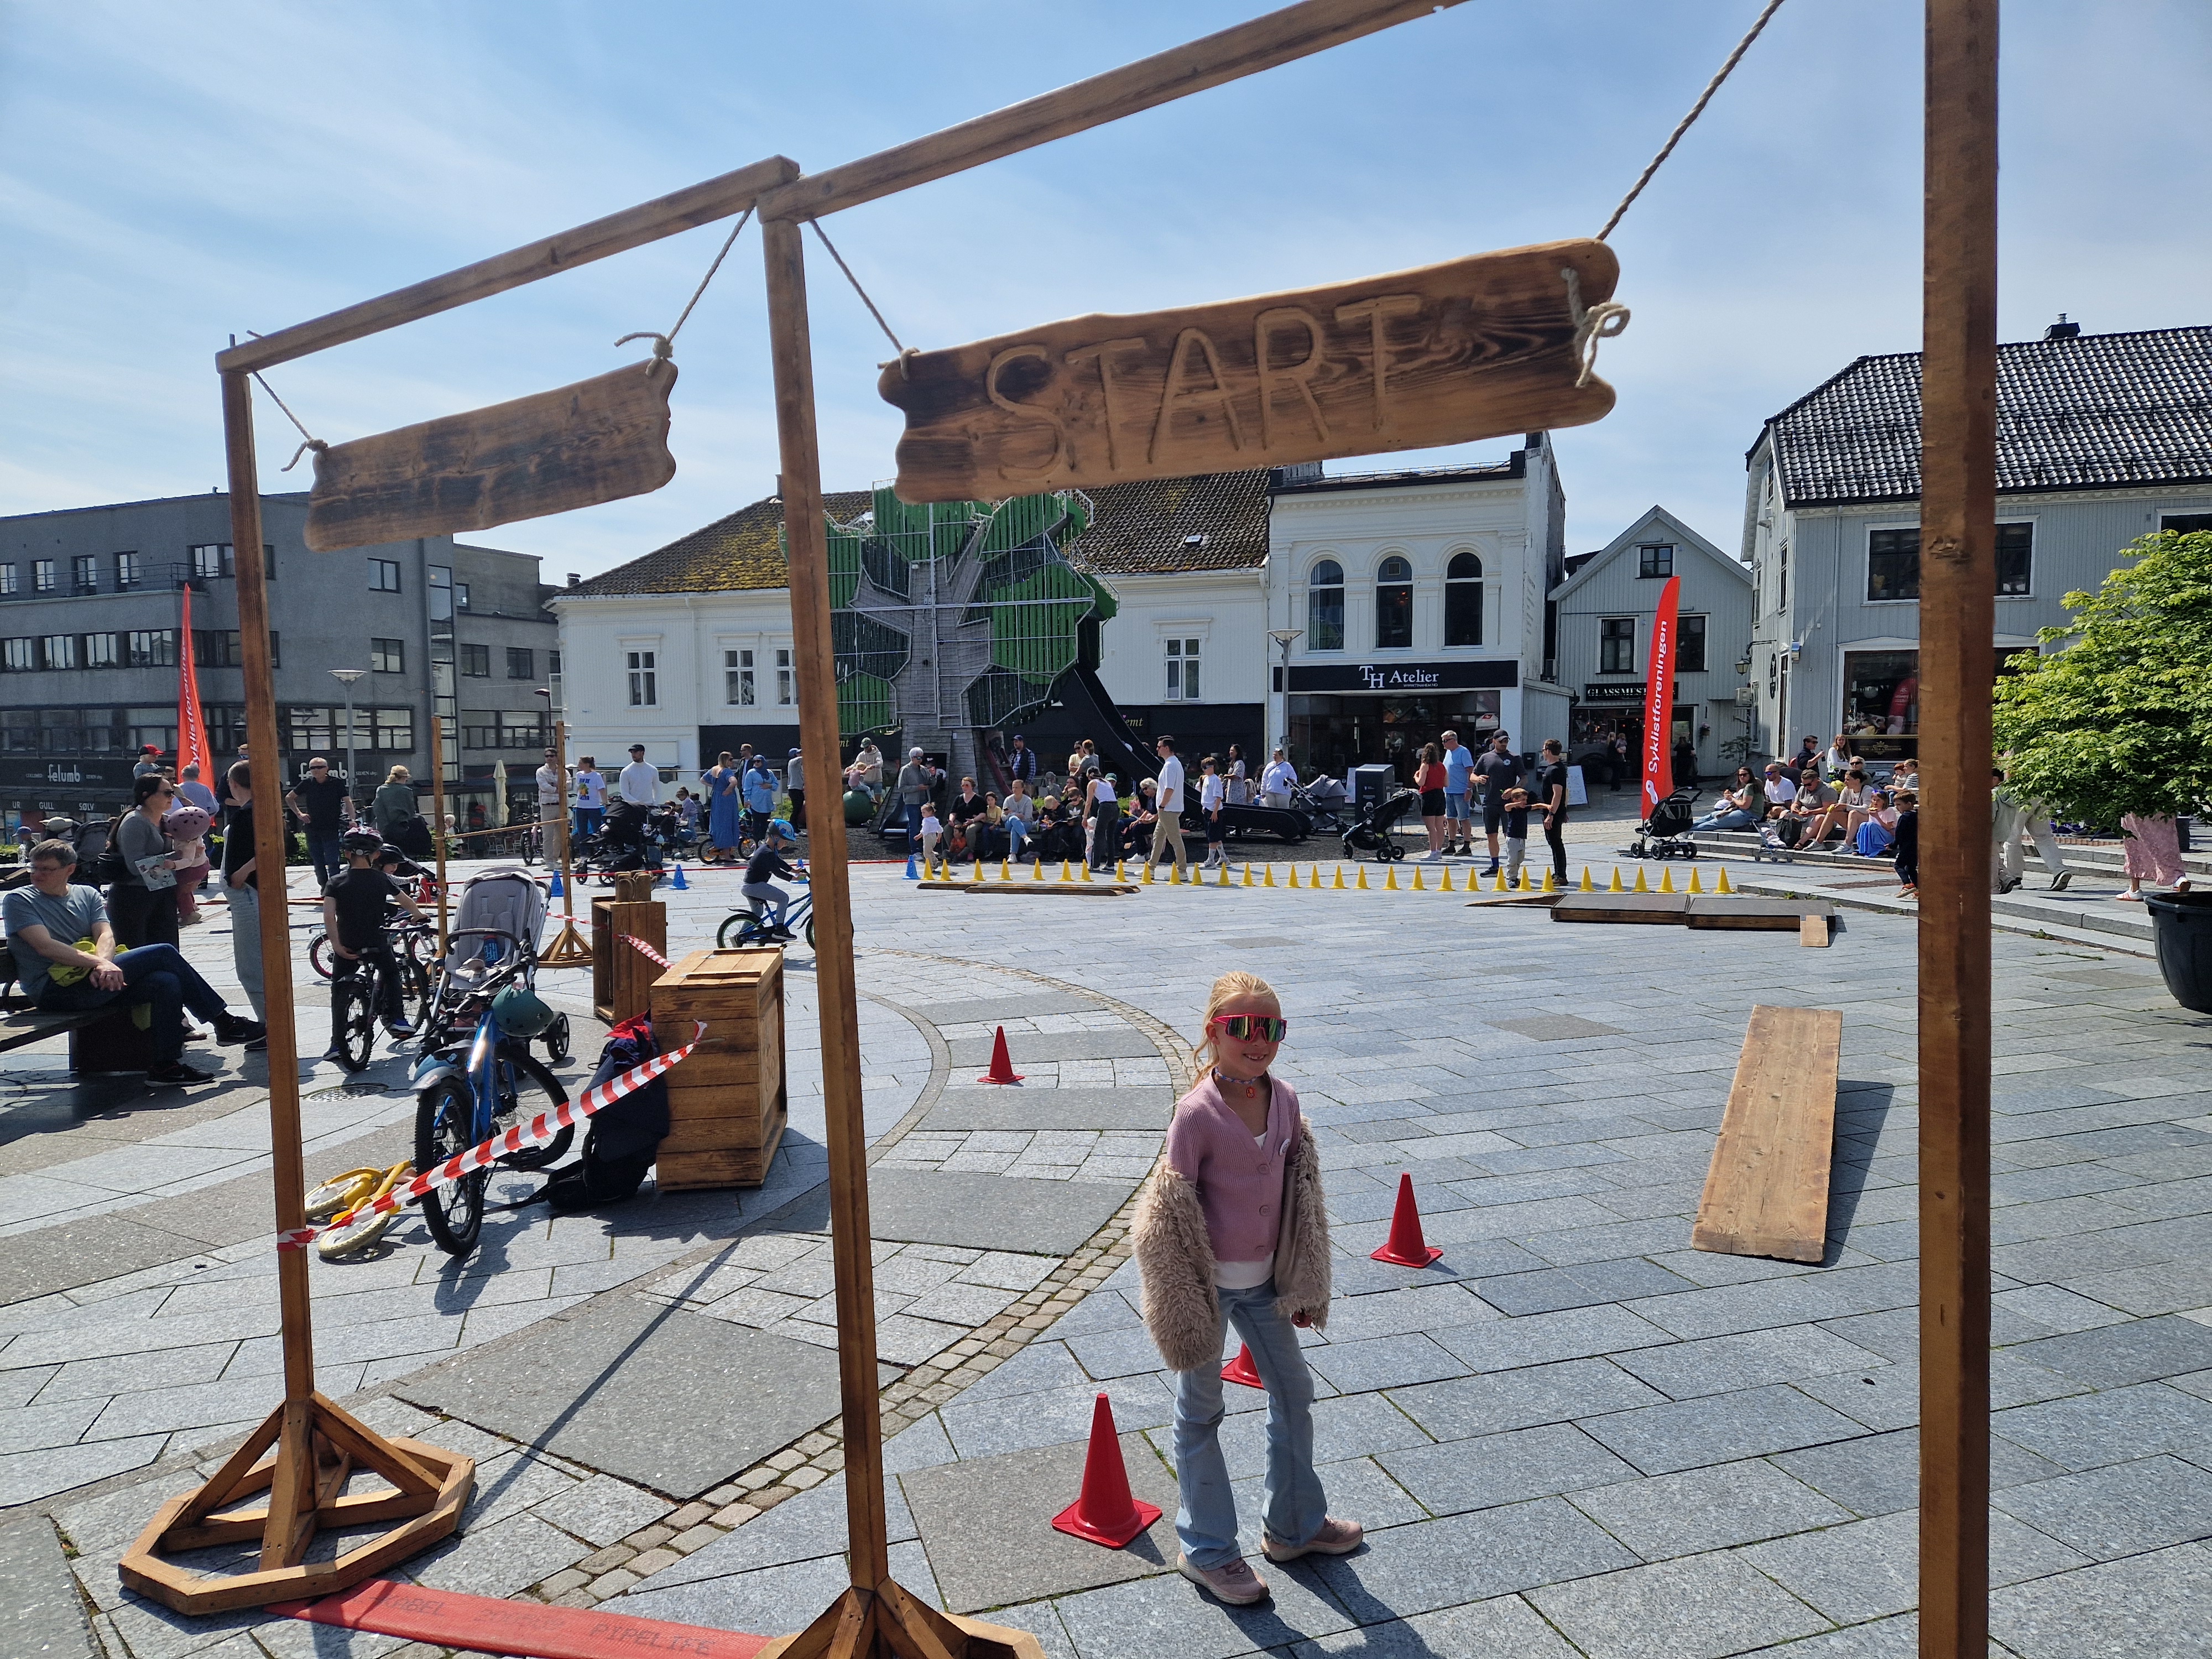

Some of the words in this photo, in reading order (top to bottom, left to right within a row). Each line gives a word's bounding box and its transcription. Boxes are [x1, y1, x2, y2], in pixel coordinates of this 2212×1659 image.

[985, 294, 1423, 482] START
[1389, 669, 1439, 683] Atelier
[1648, 620, 1667, 773] Syklistforeningen
[1125, 718, 1144, 727] emt
[48, 764, 80, 782] felumb
[589, 1623, 717, 1656] PIPELIFE
